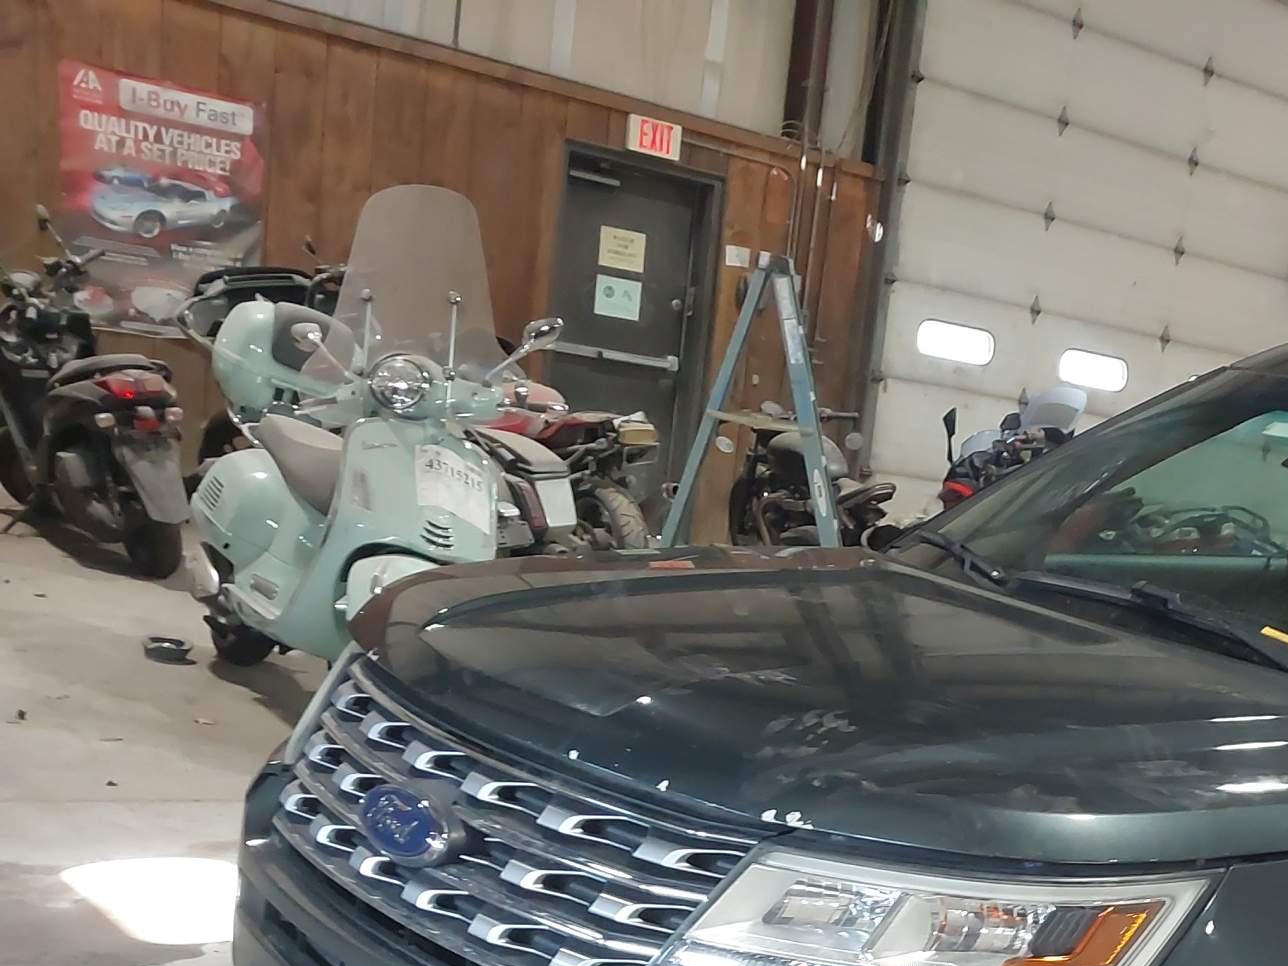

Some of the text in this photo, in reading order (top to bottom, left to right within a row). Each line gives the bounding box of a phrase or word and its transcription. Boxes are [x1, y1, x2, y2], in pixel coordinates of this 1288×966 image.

[196, 101, 237, 126] Fast
[79, 109, 241, 160] QUALITY VEHICLES
[94, 133, 231, 176] AT A SET PRICE!
[639, 118, 674, 155] EXIT
